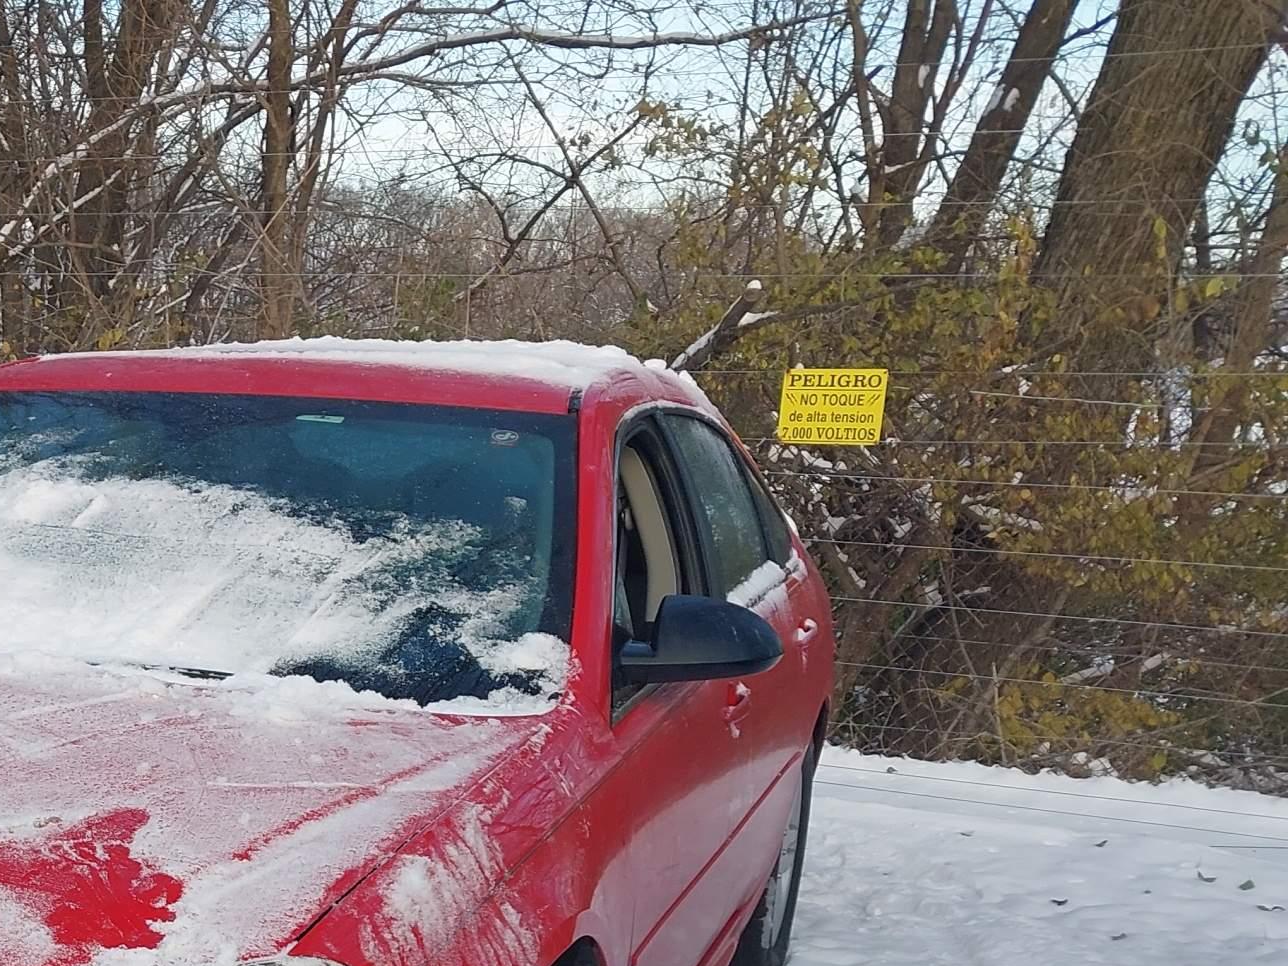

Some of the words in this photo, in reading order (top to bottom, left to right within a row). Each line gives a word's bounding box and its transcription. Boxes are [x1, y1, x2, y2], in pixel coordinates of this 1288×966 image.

[789, 375, 882, 388] PELIGRO
[799, 394, 818, 406] NO
[822, 394, 865, 406] TOQUE
[789, 411, 803, 422] de
[806, 411, 827, 423] alta
[830, 411, 874, 423] tension
[816, 427, 876, 440] VOLTIOS
